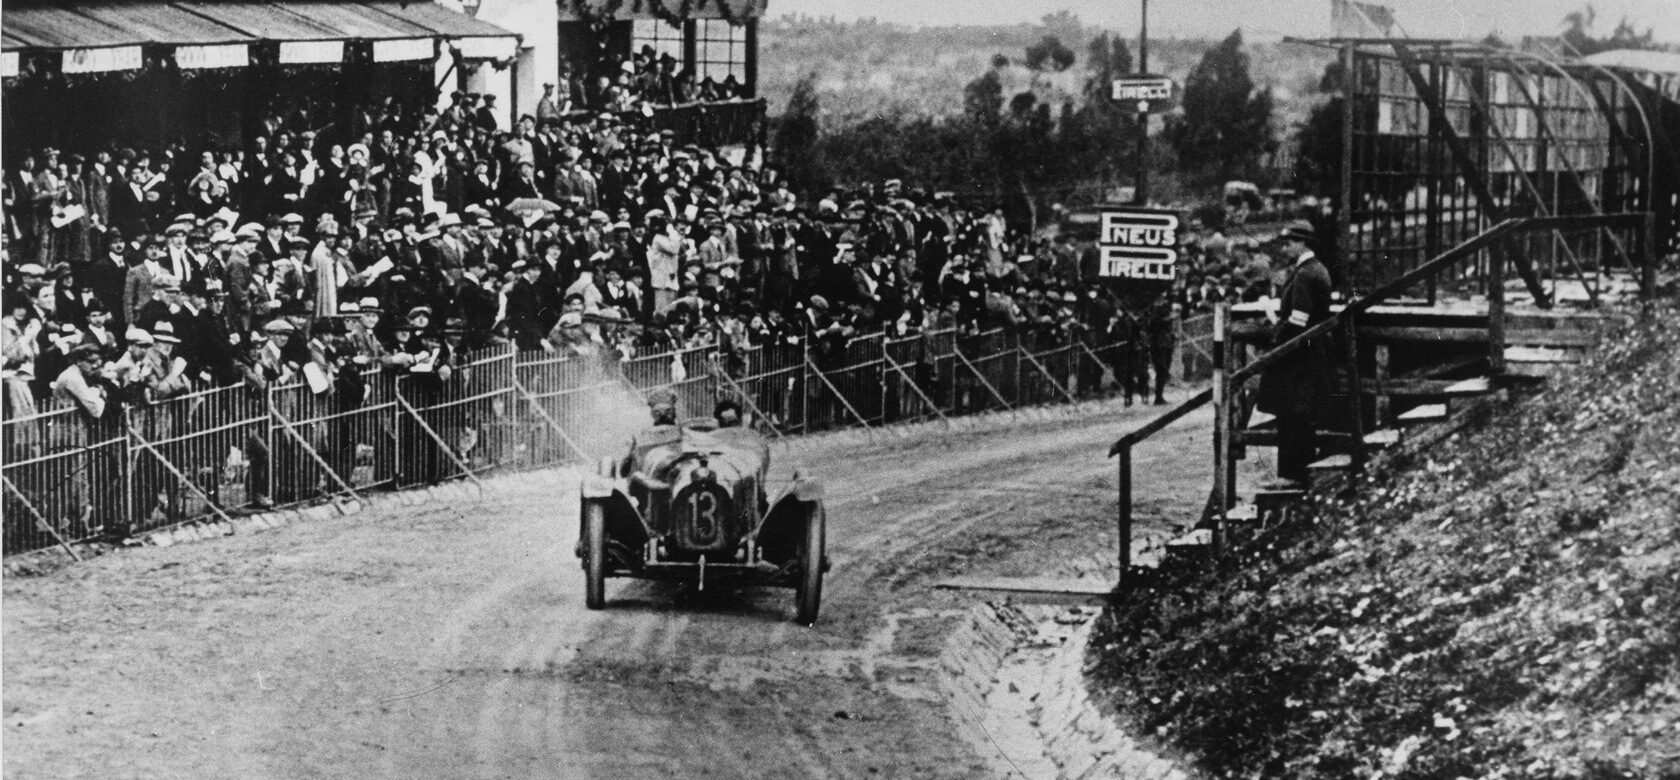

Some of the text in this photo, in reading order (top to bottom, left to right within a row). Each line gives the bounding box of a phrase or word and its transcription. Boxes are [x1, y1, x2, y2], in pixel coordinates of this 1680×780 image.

[1112, 78, 1172, 99] PIRELLI
[1101, 212, 1179, 246] PNEUS
[1099, 246, 1177, 280] PIRELLI
[688, 491, 717, 539] 13
